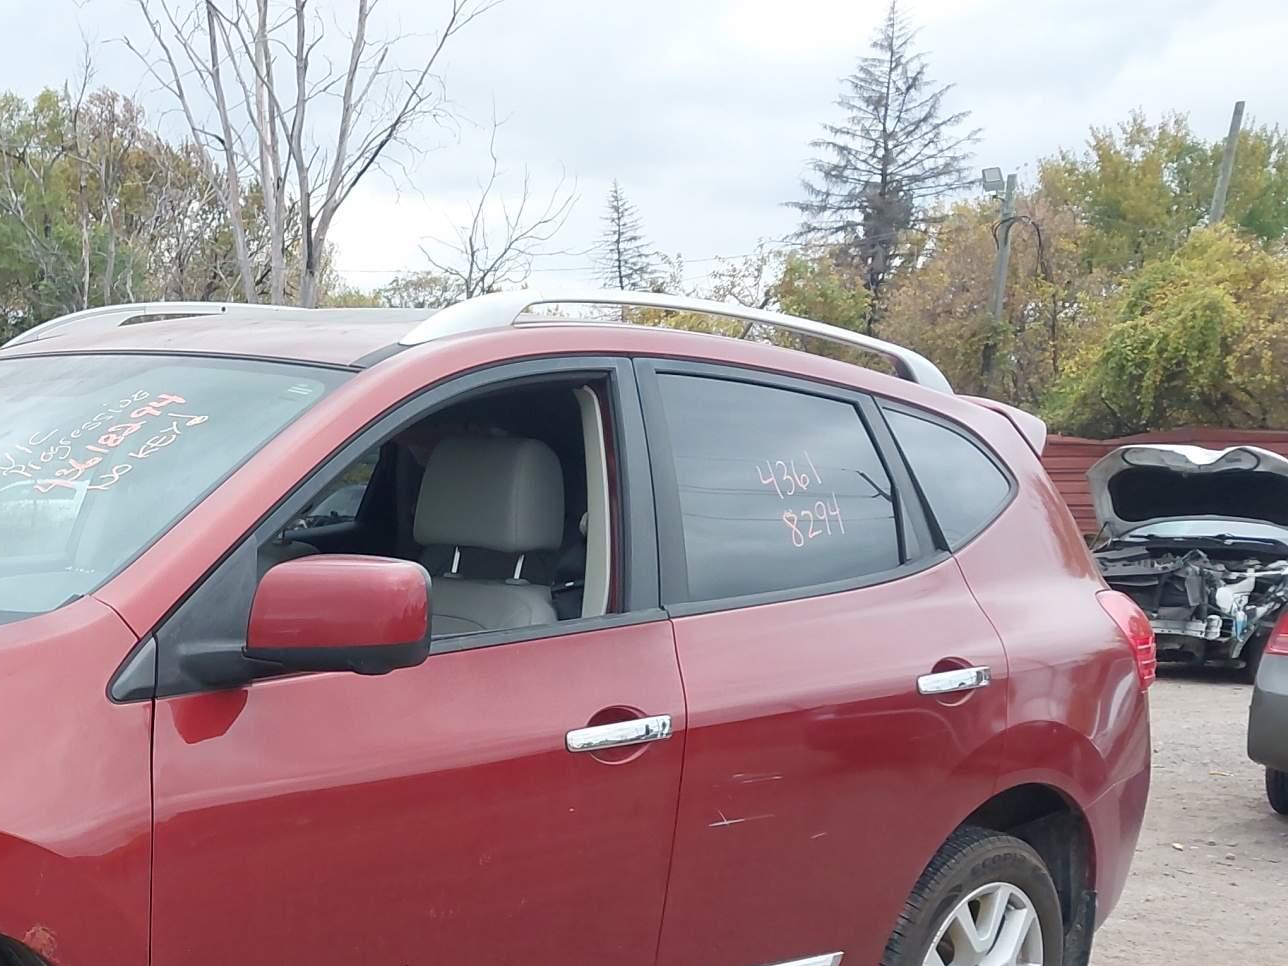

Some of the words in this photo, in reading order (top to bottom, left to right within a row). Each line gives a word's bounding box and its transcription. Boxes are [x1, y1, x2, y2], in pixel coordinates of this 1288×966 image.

[33, 393, 186, 492] 43618294
[755, 450, 822, 499] 4361
[782, 491, 845, 547] 8294
